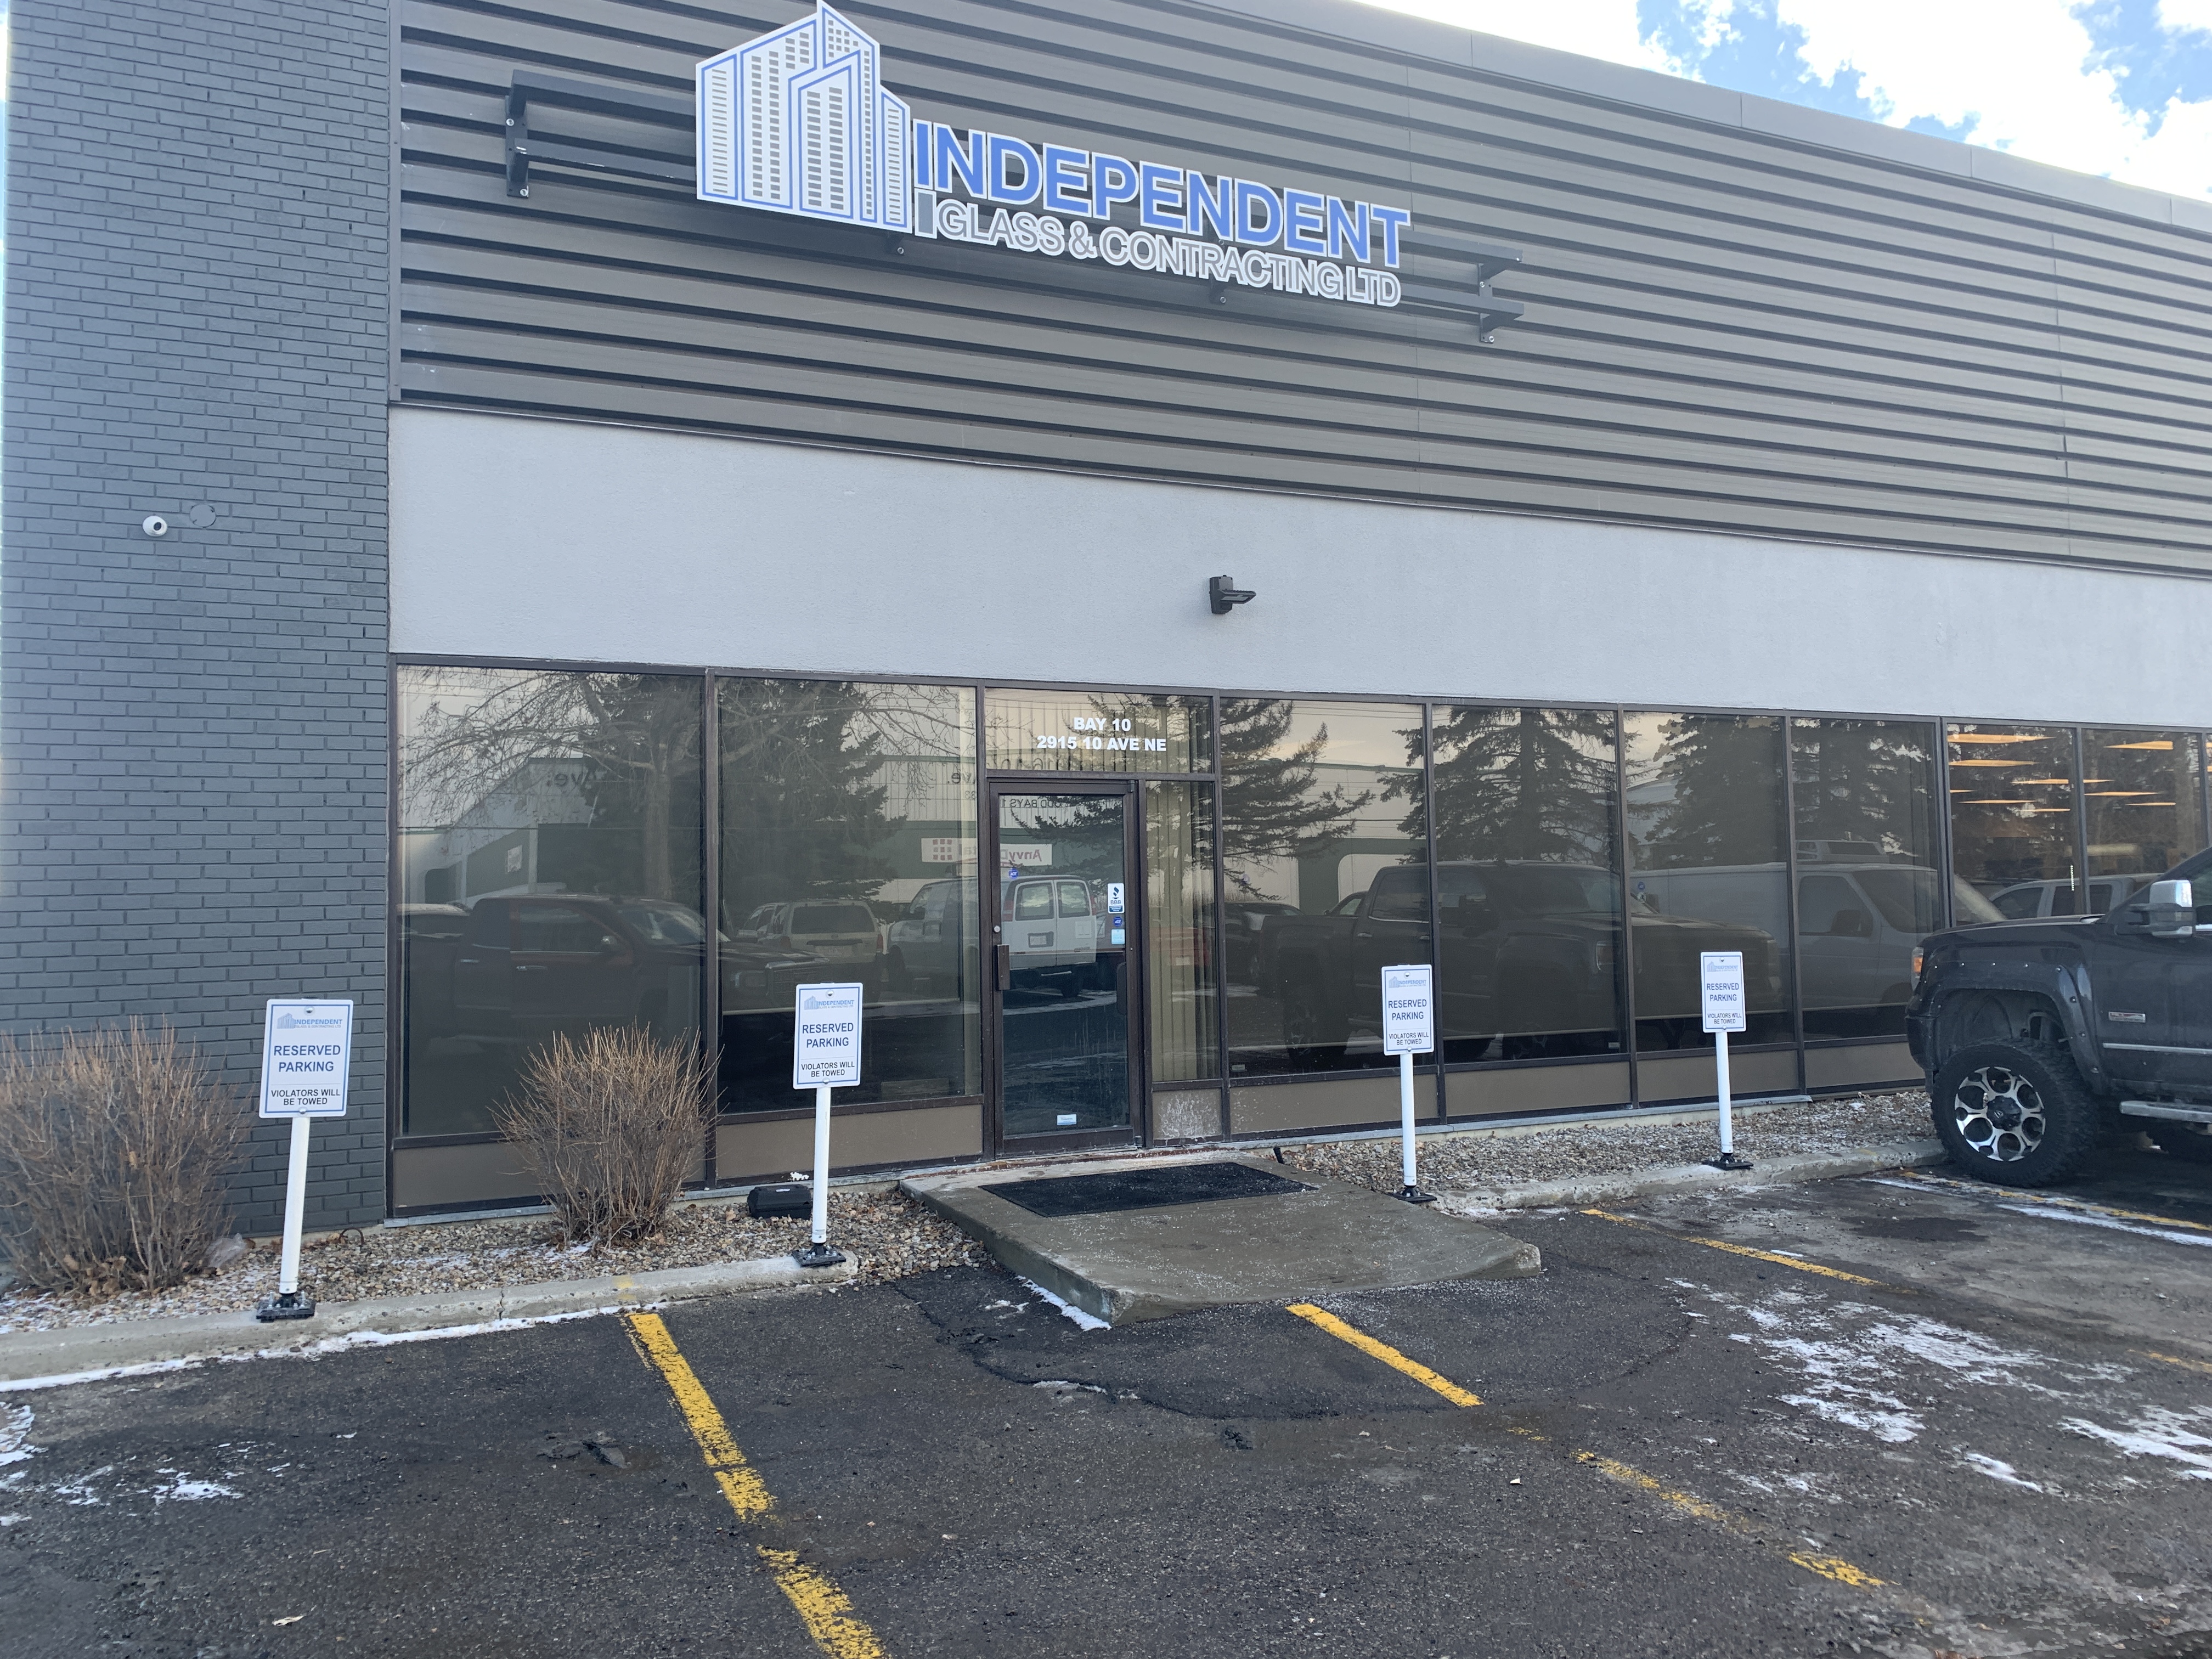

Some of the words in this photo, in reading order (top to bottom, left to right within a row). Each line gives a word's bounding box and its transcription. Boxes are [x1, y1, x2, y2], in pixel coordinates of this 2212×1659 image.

[912, 118, 1410, 268] INDEPENDENT
[935, 198, 1064, 256] GLASS
[1069, 221, 1097, 259] &
[1099, 225, 1344, 301] CONTRACTING
[1346, 265, 1401, 307] LTD
[1074, 717, 1106, 731] BAY
[1112, 718, 1131, 731] 10
[1037, 736, 1077, 749] 2915
[1082, 736, 1102, 750] 10
[1107, 738, 1139, 751] AVE
[1144, 738, 1166, 752] NE
[1388, 999, 1427, 1008] RESERVED
[1392, 1012, 1424, 1020] PARKING
[802, 1023, 854, 1034] RESERVED
[806, 1037, 849, 1048] PARKING
[274, 1045, 341, 1056] RESERVED
[279, 1061, 334, 1072] PARKING
[801, 1062, 838, 1070] VIOLATORS
[271, 1089, 319, 1097] VIOLATORS
